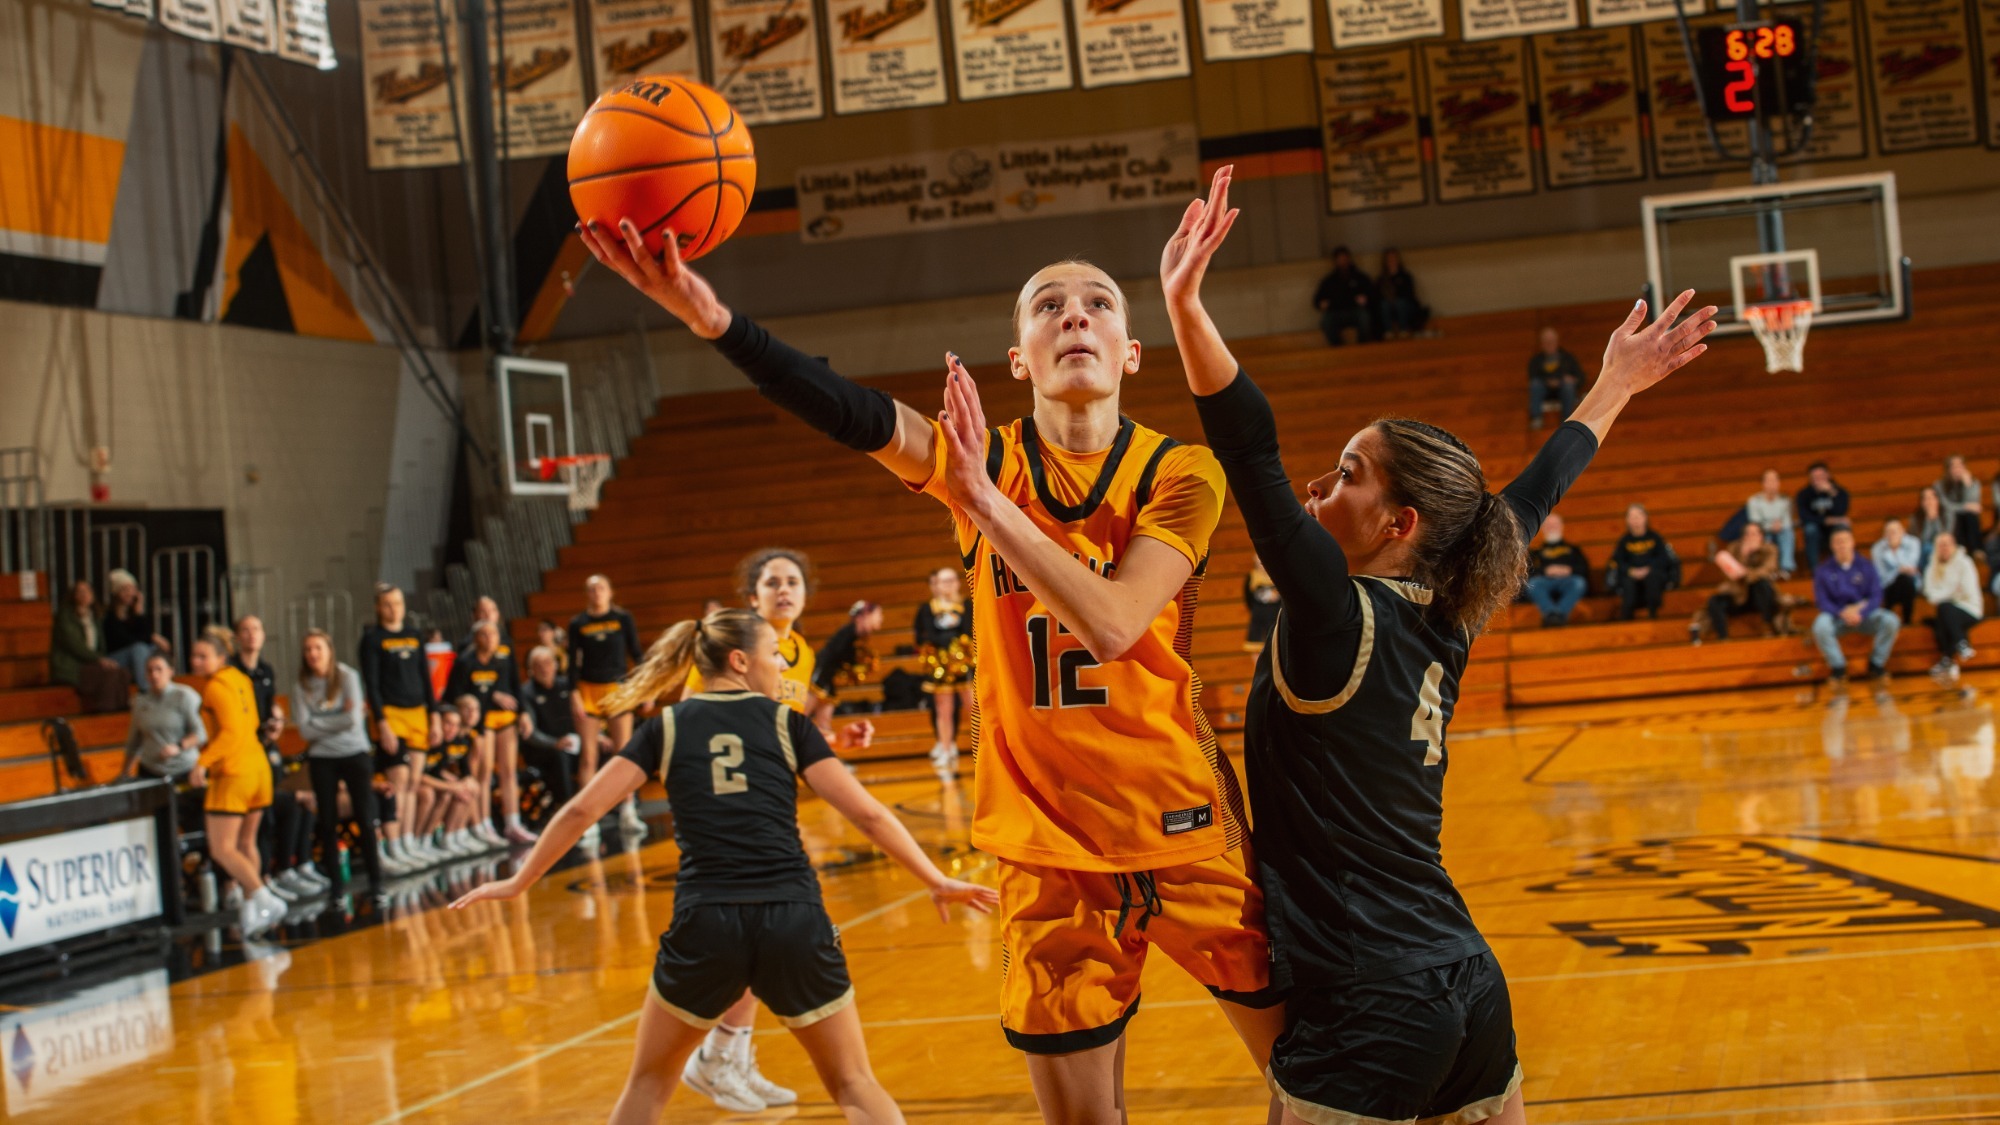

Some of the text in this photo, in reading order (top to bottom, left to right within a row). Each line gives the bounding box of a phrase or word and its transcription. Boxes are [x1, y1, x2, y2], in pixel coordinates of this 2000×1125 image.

[1724, 61, 1755, 112] 2
[1000, 142, 1128, 170] Little Huskies
[1025, 156, 1170, 187] Volleyball Club
[801, 165, 927, 194] Little Huskies
[824, 176, 974, 212] Basketball Club
[1109, 178, 1196, 201] Fan Zone
[908, 200, 995, 222] Fan Zone
[1027, 615, 1109, 709] 12
[1411, 661, 1445, 767] 4
[709, 733, 748, 795] 2
[1198, 812, 1207, 823] M
[26, 843, 152, 910] SUPERIOR
[46, 905, 103, 929] NATIONAL
